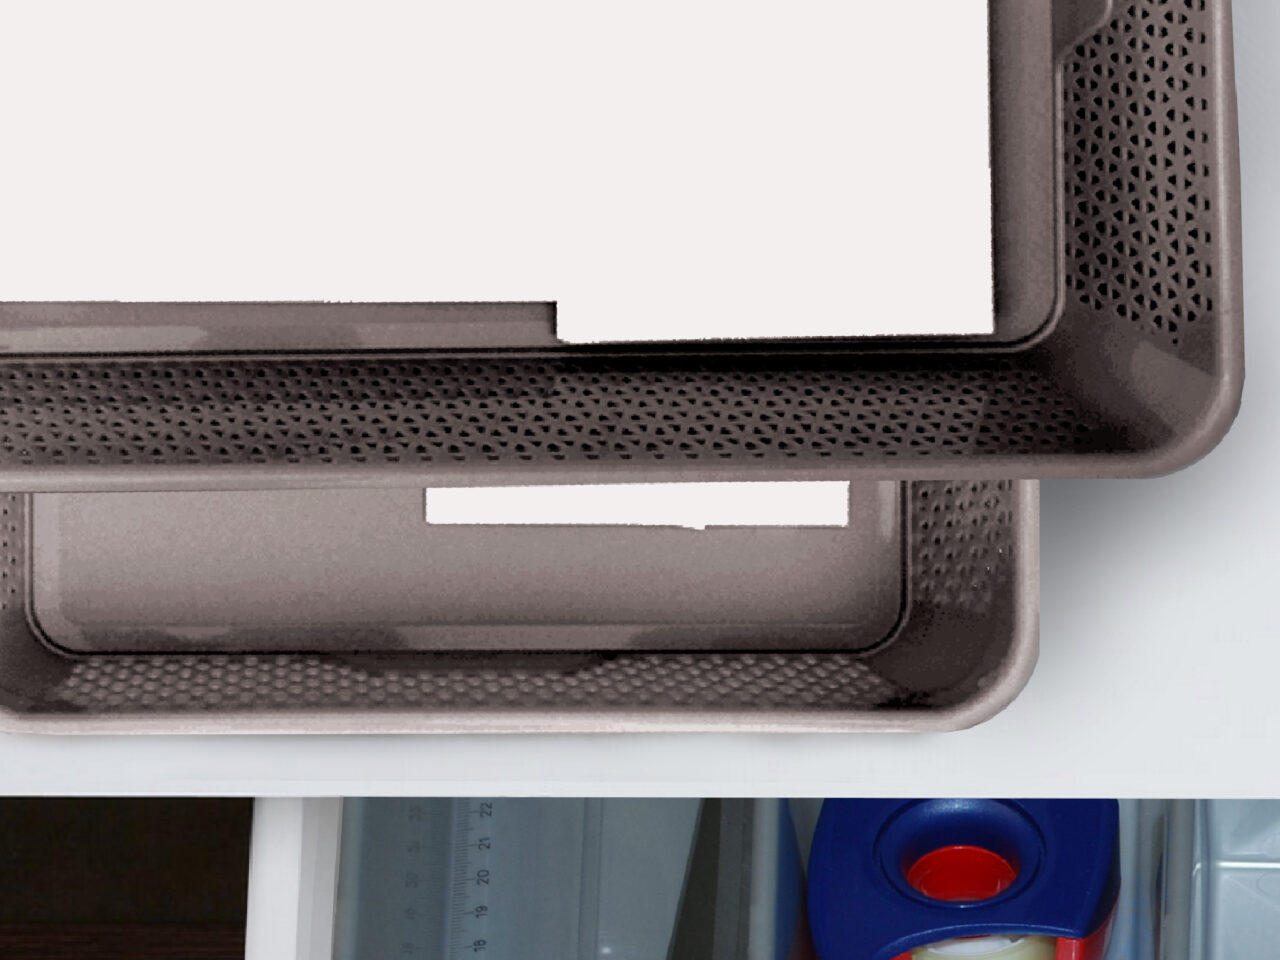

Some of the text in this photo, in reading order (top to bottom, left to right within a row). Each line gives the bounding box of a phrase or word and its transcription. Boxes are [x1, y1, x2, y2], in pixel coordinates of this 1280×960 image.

[479, 802, 493, 818] 22
[477, 837, 491, 851] 21
[476, 869, 490, 885] 20
[475, 904, 488, 919] 19
